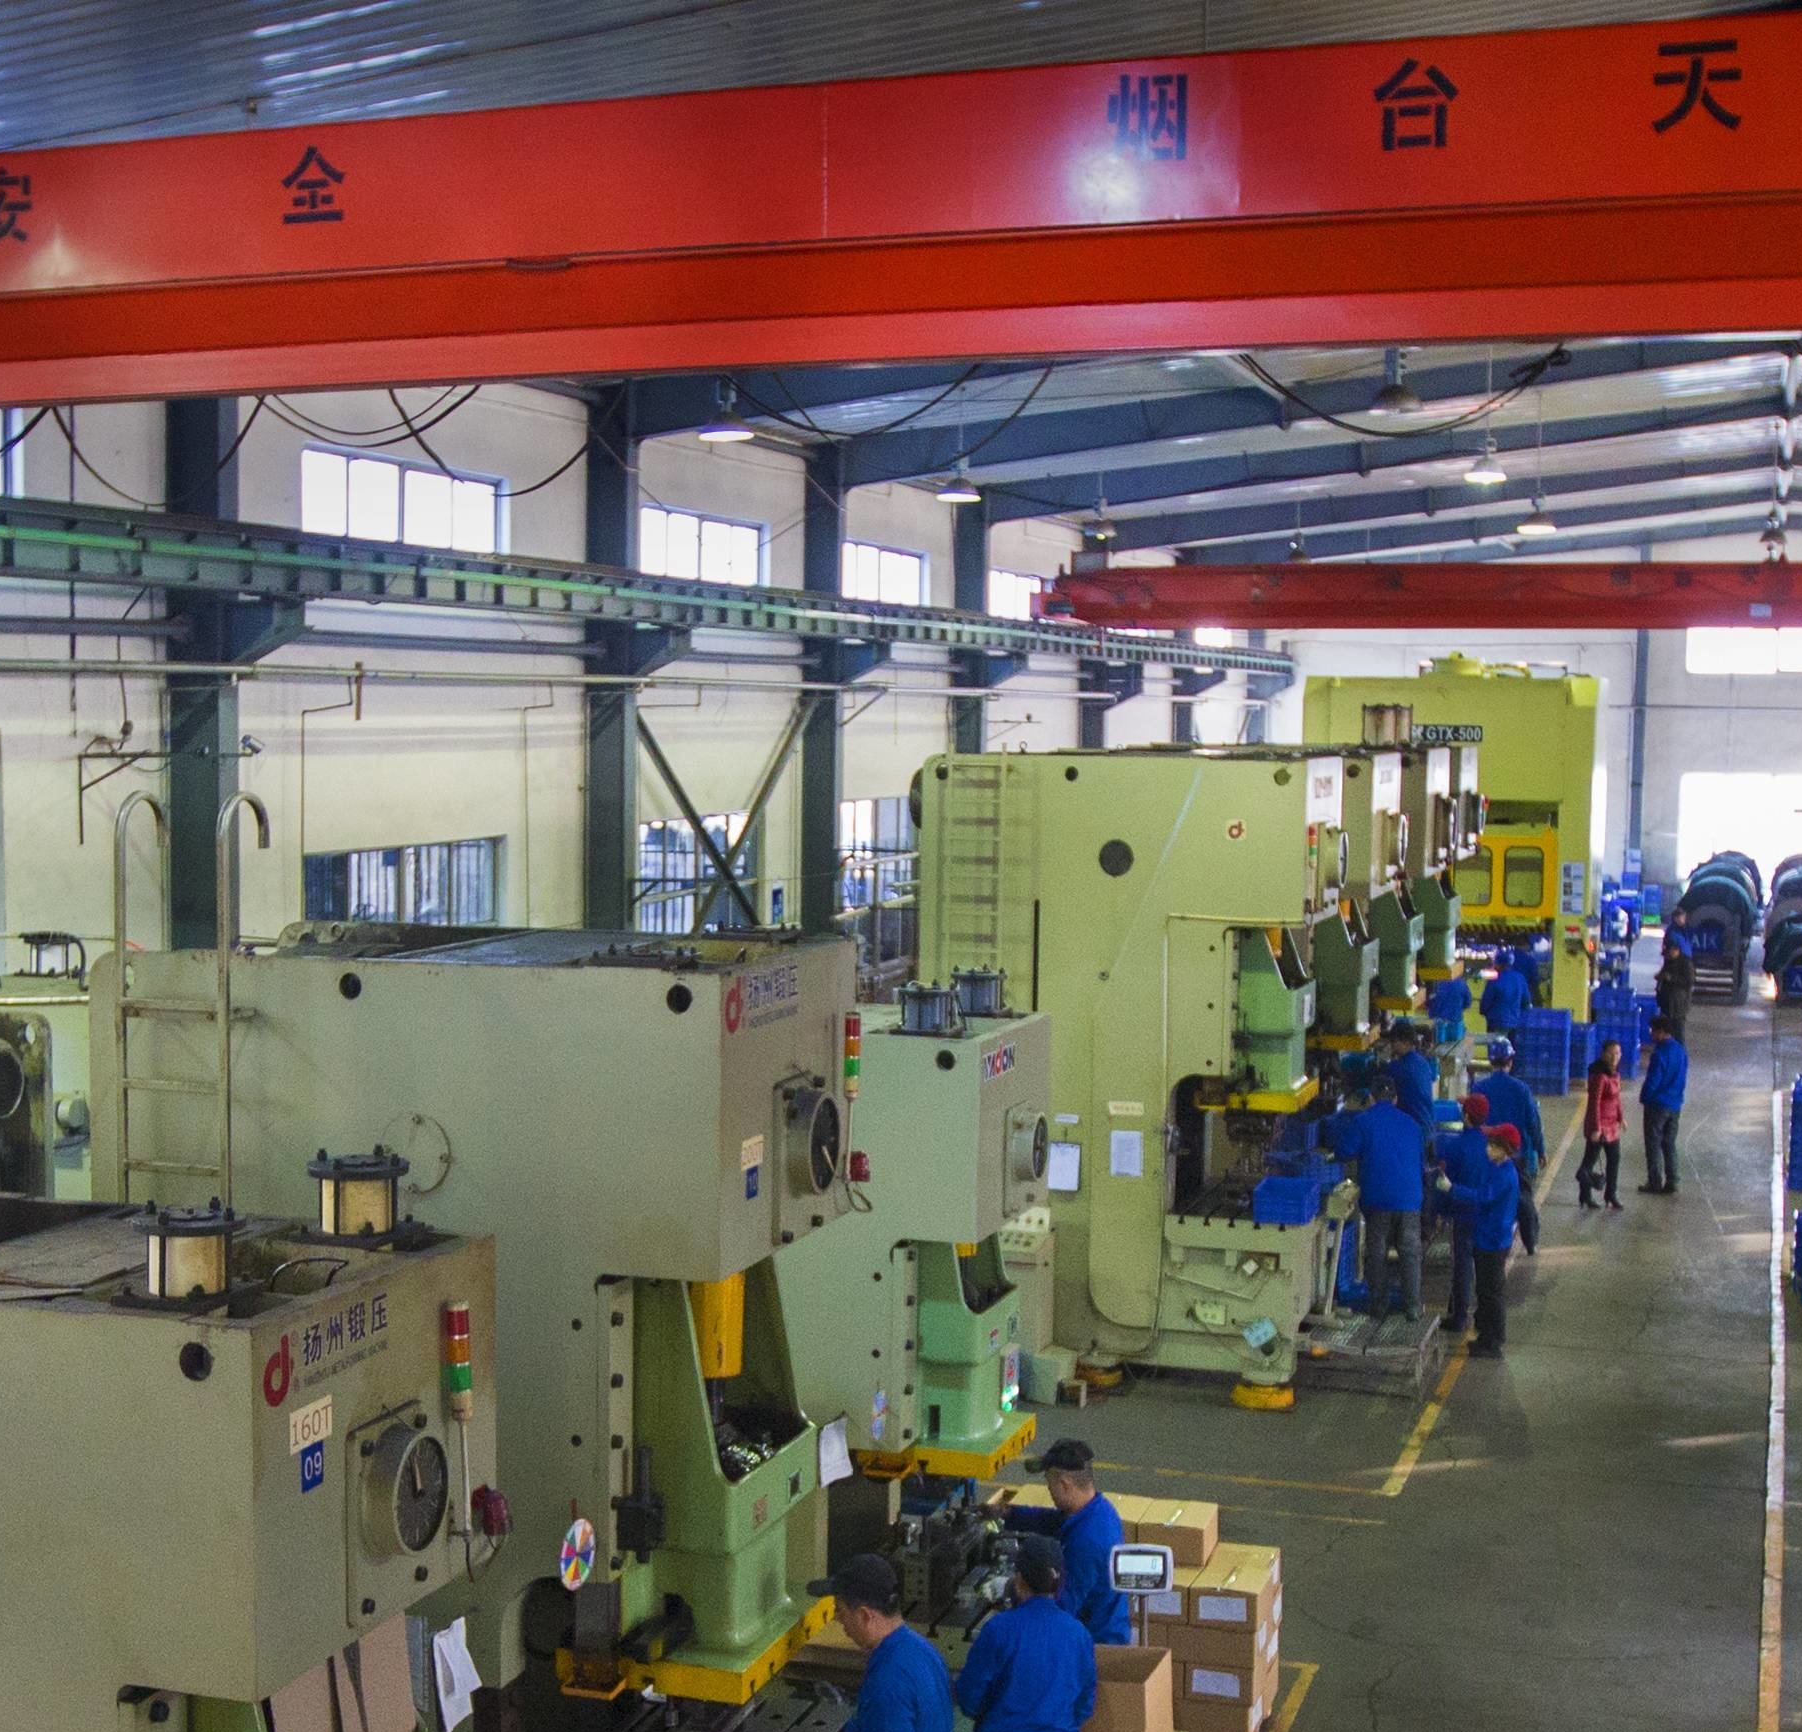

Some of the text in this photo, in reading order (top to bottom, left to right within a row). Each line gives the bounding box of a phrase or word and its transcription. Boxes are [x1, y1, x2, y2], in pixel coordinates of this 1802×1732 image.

[1426, 726, 1482, 741] GTX-500
[303, 1293, 387, 1366] 扬州锻压
[293, 1404, 332, 1447] 160T
[305, 1451, 322, 1480] 09
